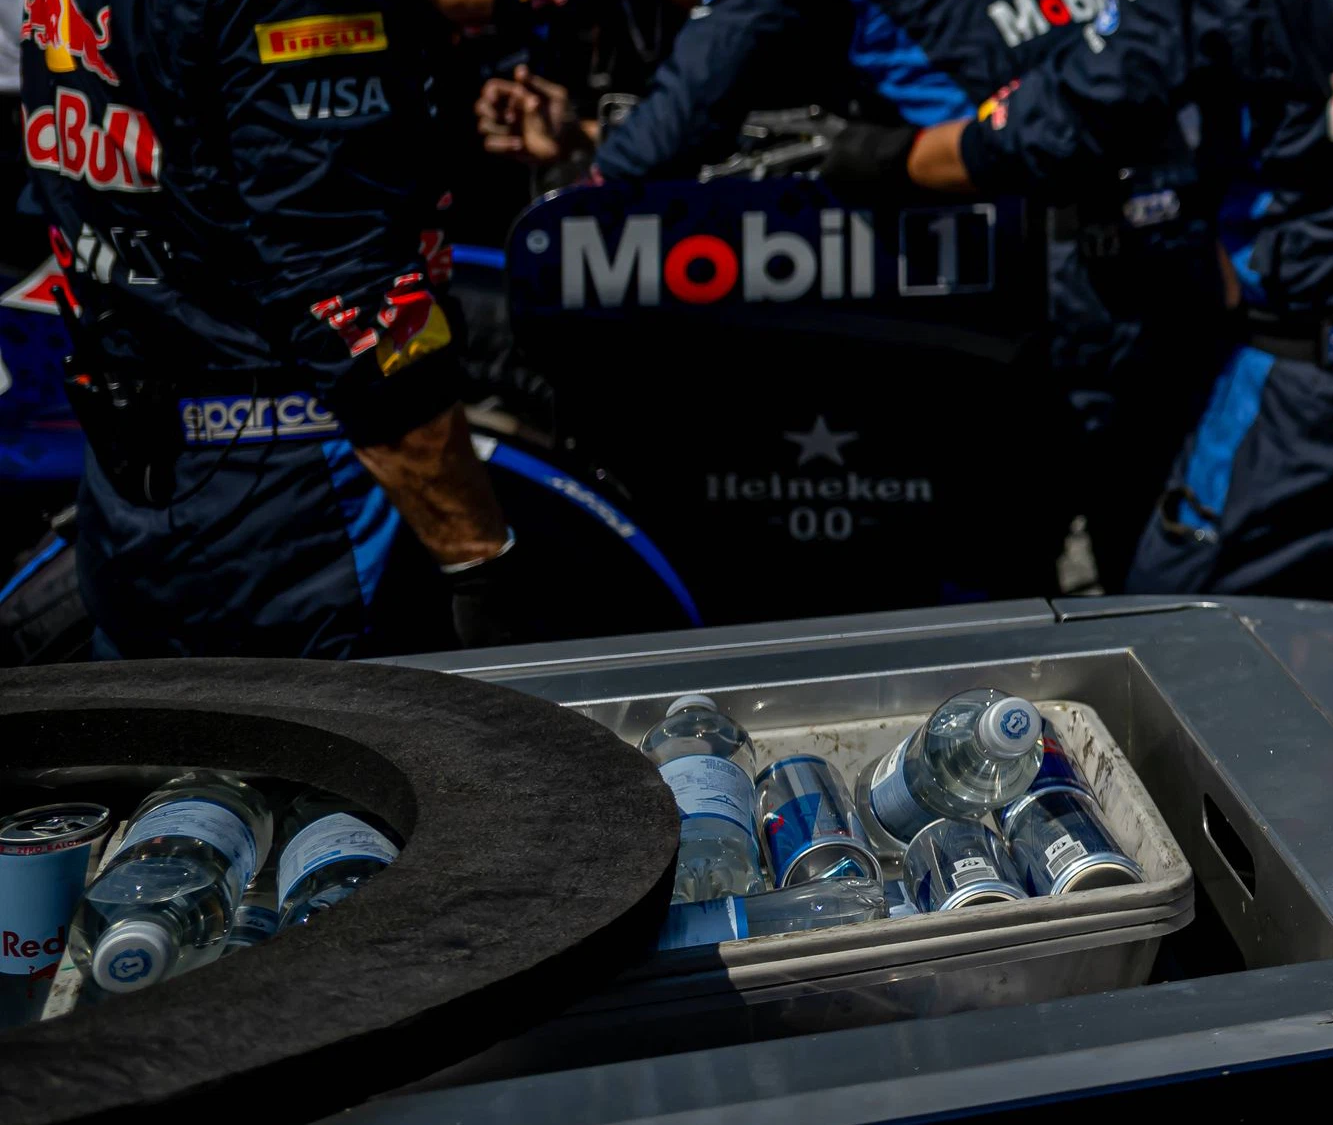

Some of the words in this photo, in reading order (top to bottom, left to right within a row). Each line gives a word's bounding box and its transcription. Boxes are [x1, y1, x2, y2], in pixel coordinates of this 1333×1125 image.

[268, 20, 376, 54] PIRELLI
[282, 76, 392, 121] VISA
[560, 207, 876, 312] Mobil
[704, 469, 935, 503] Heineken
[2, 925, 66, 959] Red
